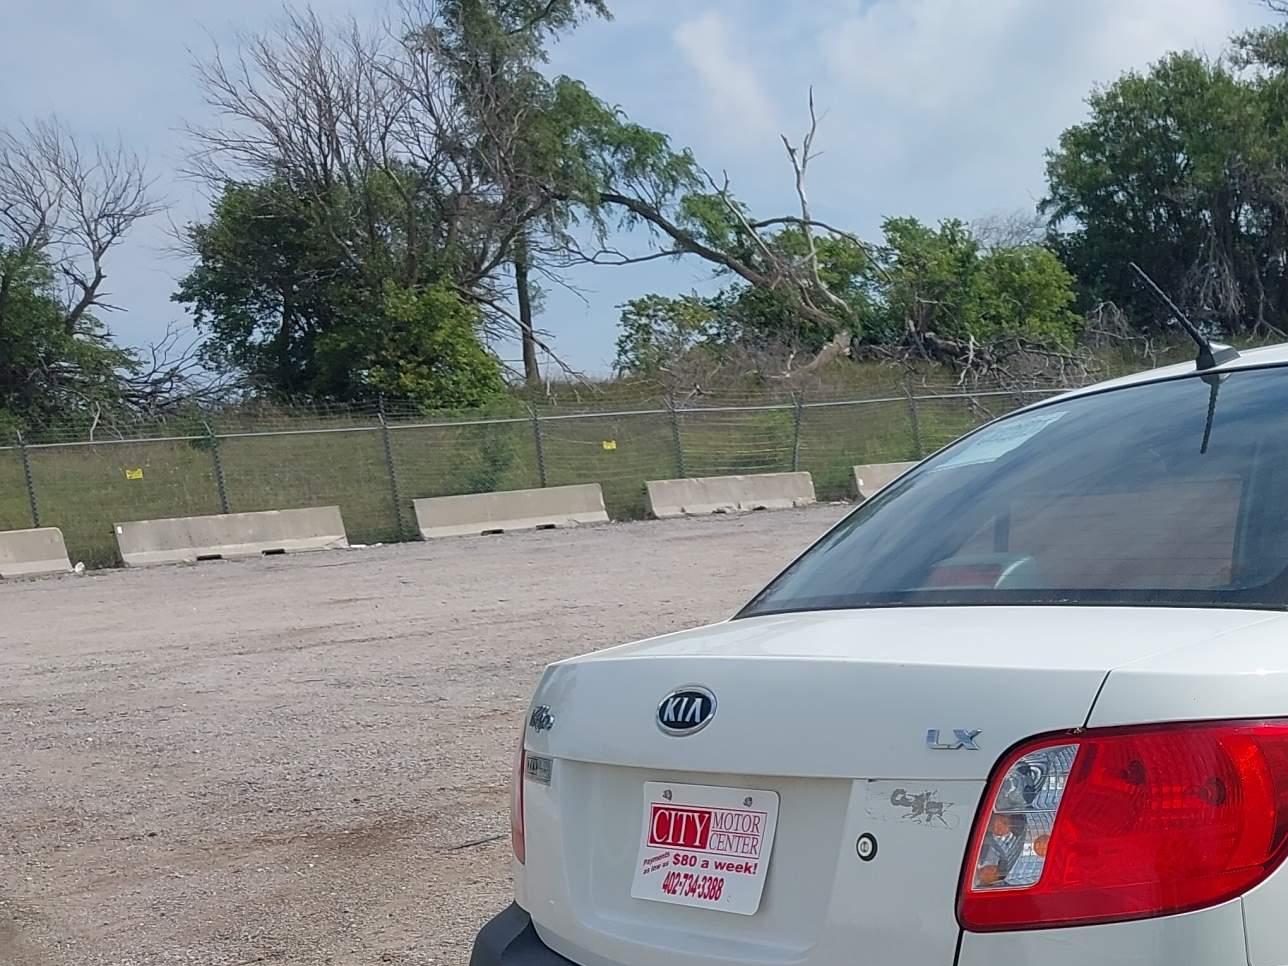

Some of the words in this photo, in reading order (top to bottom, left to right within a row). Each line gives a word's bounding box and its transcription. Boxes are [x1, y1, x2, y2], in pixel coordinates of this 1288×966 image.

[663, 697, 703, 723] KIA
[926, 728, 983, 750] LX
[653, 808, 710, 847] CITY
[711, 811, 761, 834] MOTOR
[708, 832, 759, 856] CENTER
[643, 851, 671, 867] Payments
[672, 853, 698, 867] $80
[700, 859, 710, 869] a
[714, 860, 758, 875] week!
[661, 870, 725, 901] 402-734-3388
